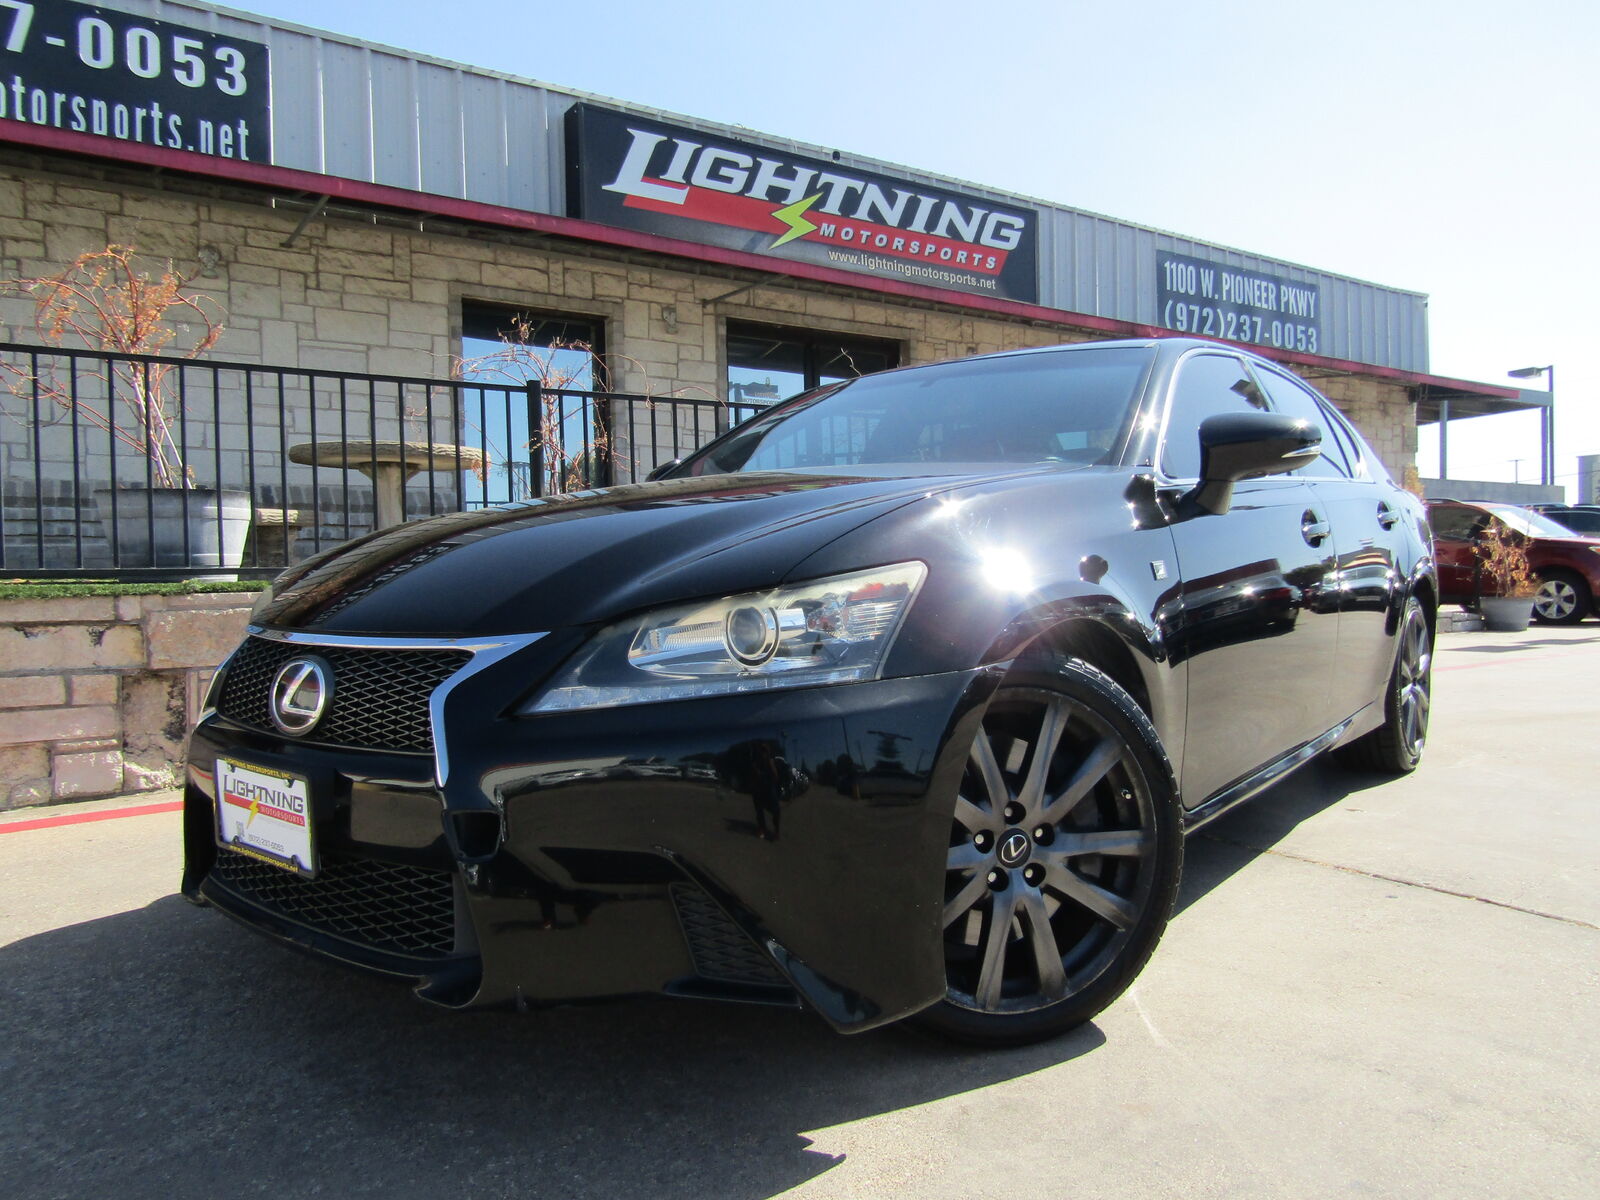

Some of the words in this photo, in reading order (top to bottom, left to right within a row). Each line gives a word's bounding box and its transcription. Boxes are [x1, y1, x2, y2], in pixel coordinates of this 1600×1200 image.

[0, 1, 248, 97] 7-0053
[602, 128, 1025, 251] LIGHTNING
[819, 223, 996, 270] MOTORSPORTS
[829, 251, 996, 290] www.lightningmotorsports.net
[1164, 261, 1196, 296] 1100
[1200, 267, 1219, 300] W.
[1222, 272, 1277, 312] PIONEER
[1281, 285, 1316, 319] PKWY
[1164, 300, 1318, 354] (972)237-0053
[223, 774, 304, 814] LIGHTNING
[260, 806, 304, 826] MOTORSPORTS
